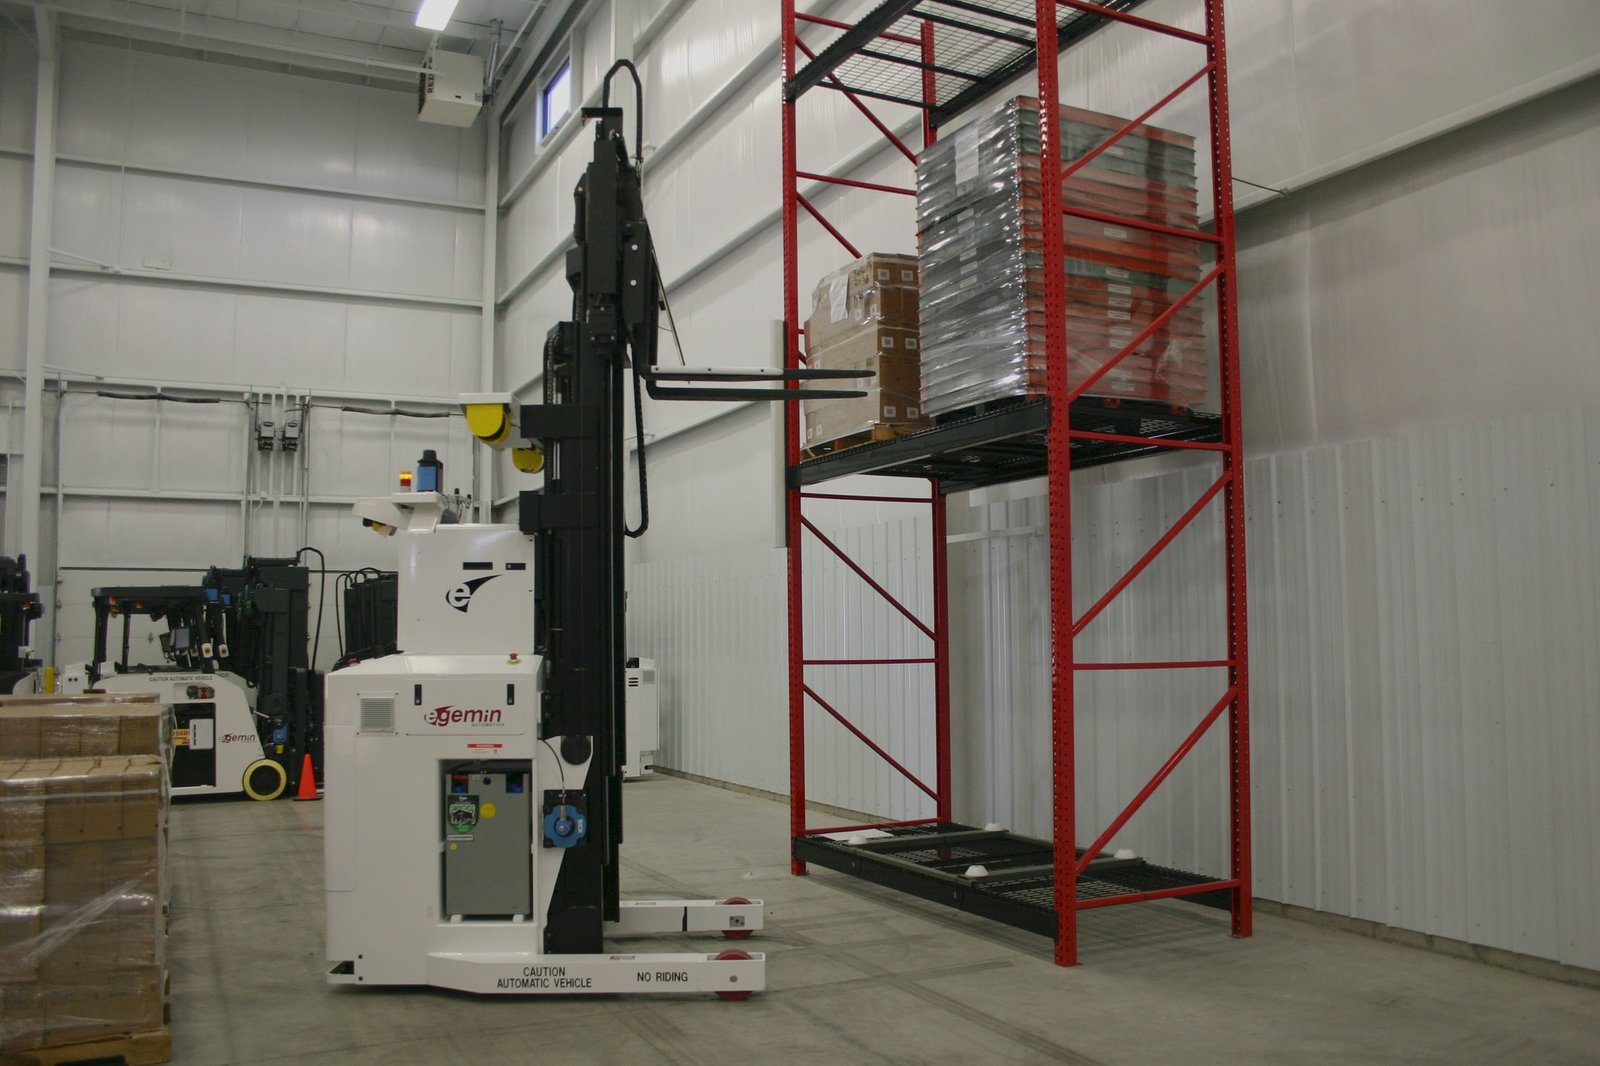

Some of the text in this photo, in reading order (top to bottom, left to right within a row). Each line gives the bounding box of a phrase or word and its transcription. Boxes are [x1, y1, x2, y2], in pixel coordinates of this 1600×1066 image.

[424, 705, 502, 727] egemin
[523, 966, 566, 977] CAUTION
[636, 971, 689, 983] NO RIDING
[496, 977, 592, 989] AUTOMATIC VEHICLE
